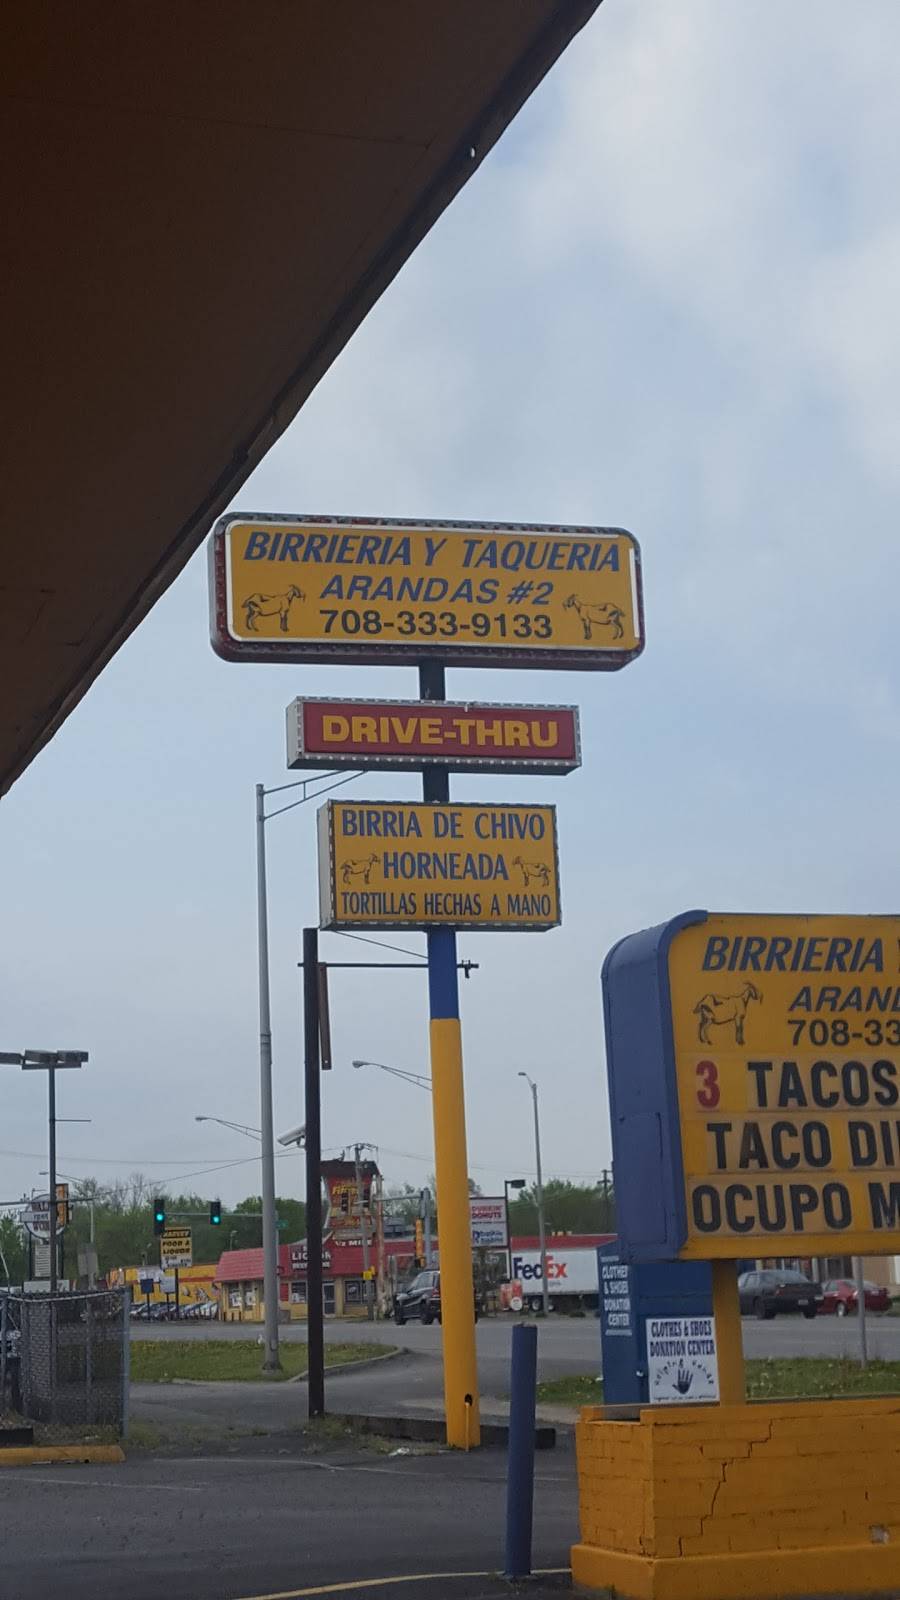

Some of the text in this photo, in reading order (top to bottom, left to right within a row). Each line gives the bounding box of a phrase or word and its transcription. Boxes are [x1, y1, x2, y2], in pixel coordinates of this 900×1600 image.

[243, 531, 621, 572] BIRRIERIA Y TAQUERIA
[320, 575, 554, 606] ARANDAS #2
[319, 609, 554, 639] 708-333-9133
[322, 714, 559, 748] DRIVE-THRU
[342, 809, 546, 841] BIRRIA DE CHIVO
[383, 851, 510, 881] HORNEADA
[341, 892, 551, 917] TORTILLAS HECHAS A MANO
[701, 936, 884, 973] BIRRIERIA
[788, 1019, 900, 1047] 708-33
[695, 1060, 899, 1109] 3 TACOS
[706, 1120, 900, 1170] TACO DI
[691, 1182, 852, 1233] OCUPO
[513, 1255, 568, 1280] FedEx
[602, 1264, 629, 1279] CLOTHES
[608, 1313, 630, 1326] CENTER
[651, 1321, 682, 1338] CLOTHES
[683, 1320, 689, 1337] &
[690, 1320, 712, 1336] SHOES
[650, 1339, 715, 1357] DONATION CENTER
